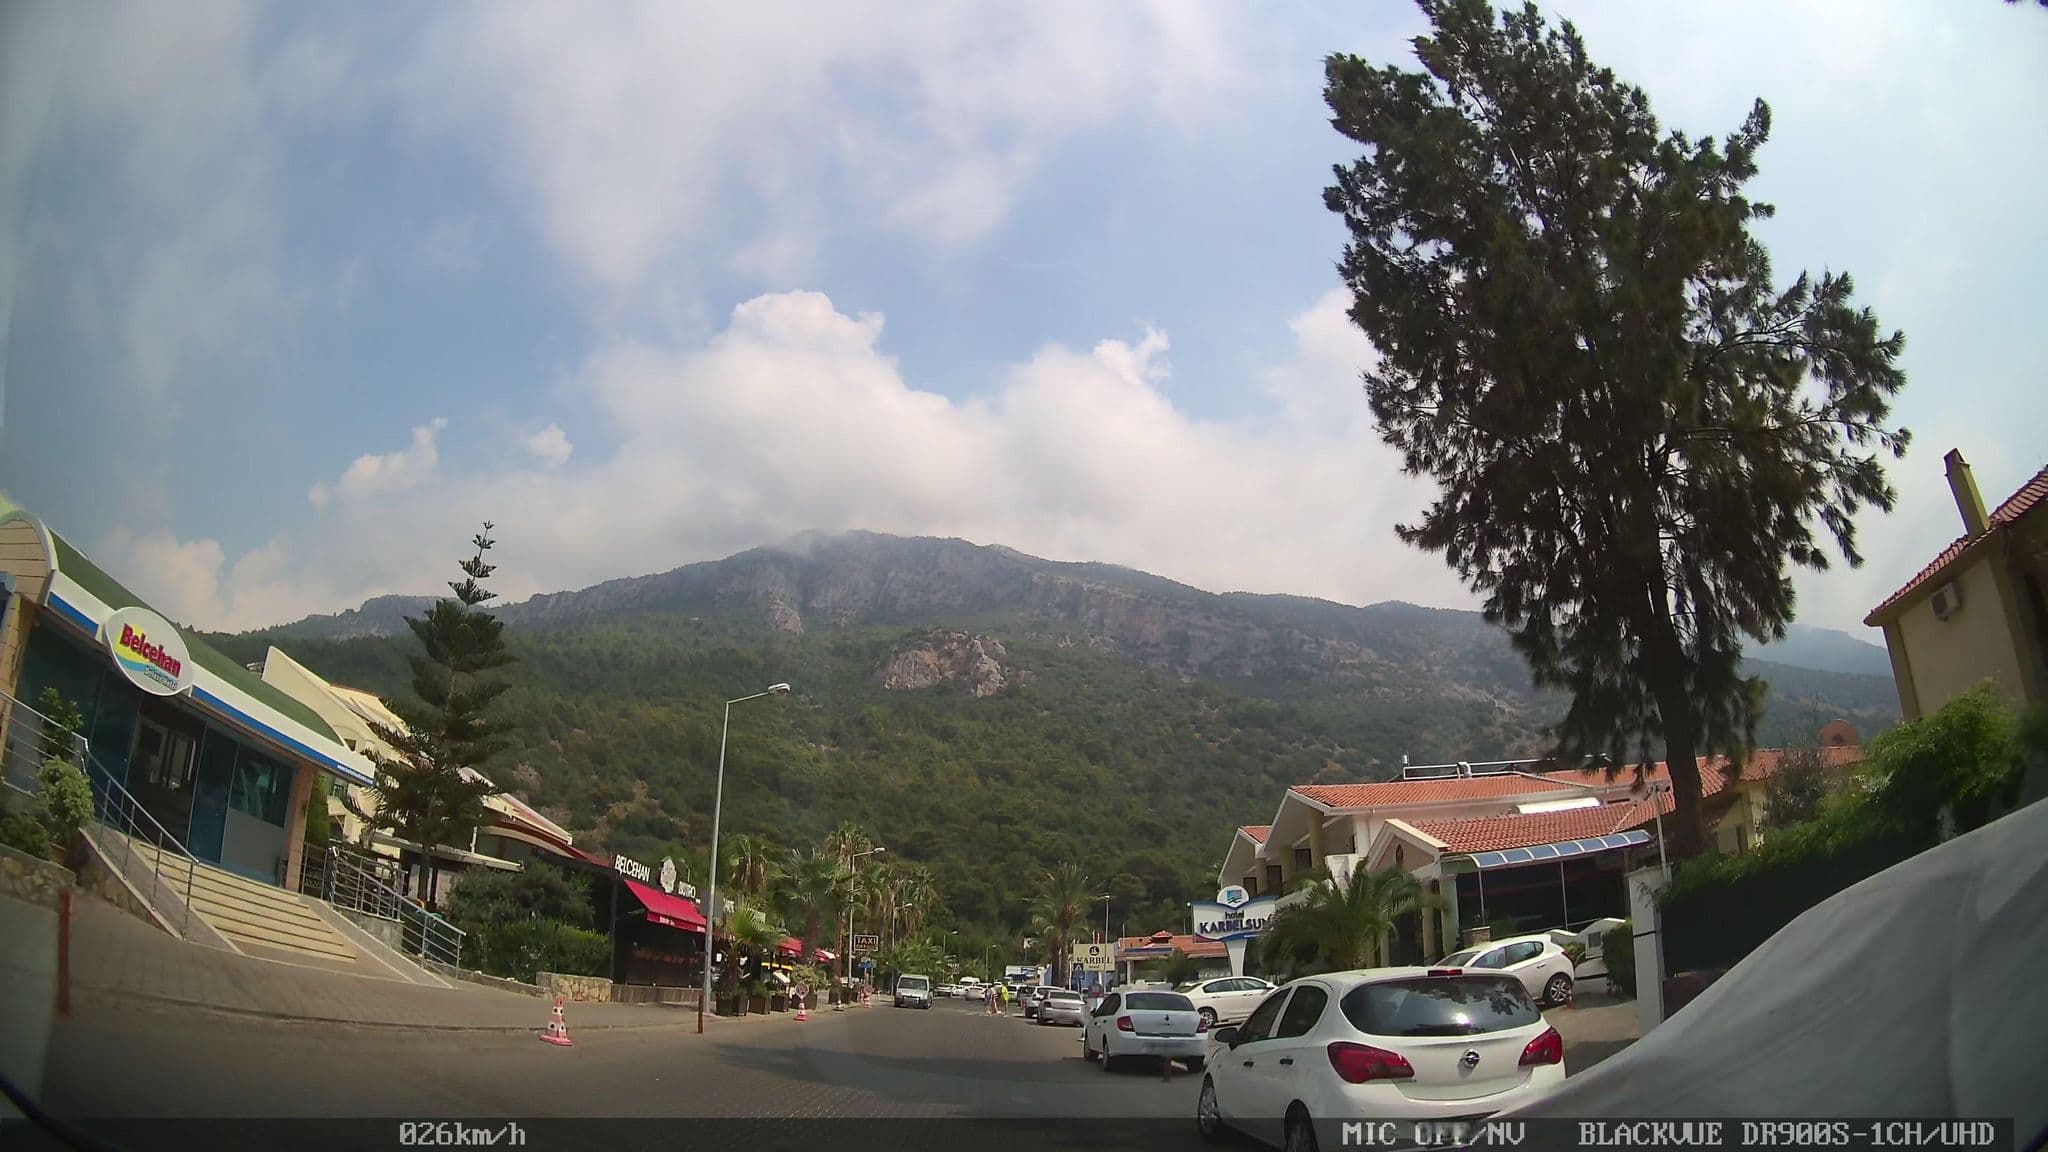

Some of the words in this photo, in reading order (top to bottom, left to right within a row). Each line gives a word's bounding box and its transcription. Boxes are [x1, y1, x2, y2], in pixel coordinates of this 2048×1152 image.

[119, 623, 181, 678] Belcehan
[614, 854, 650, 882] BELCEHAN
[1224, 909, 1245, 920] hotel
[856, 936, 876, 945] TAXI
